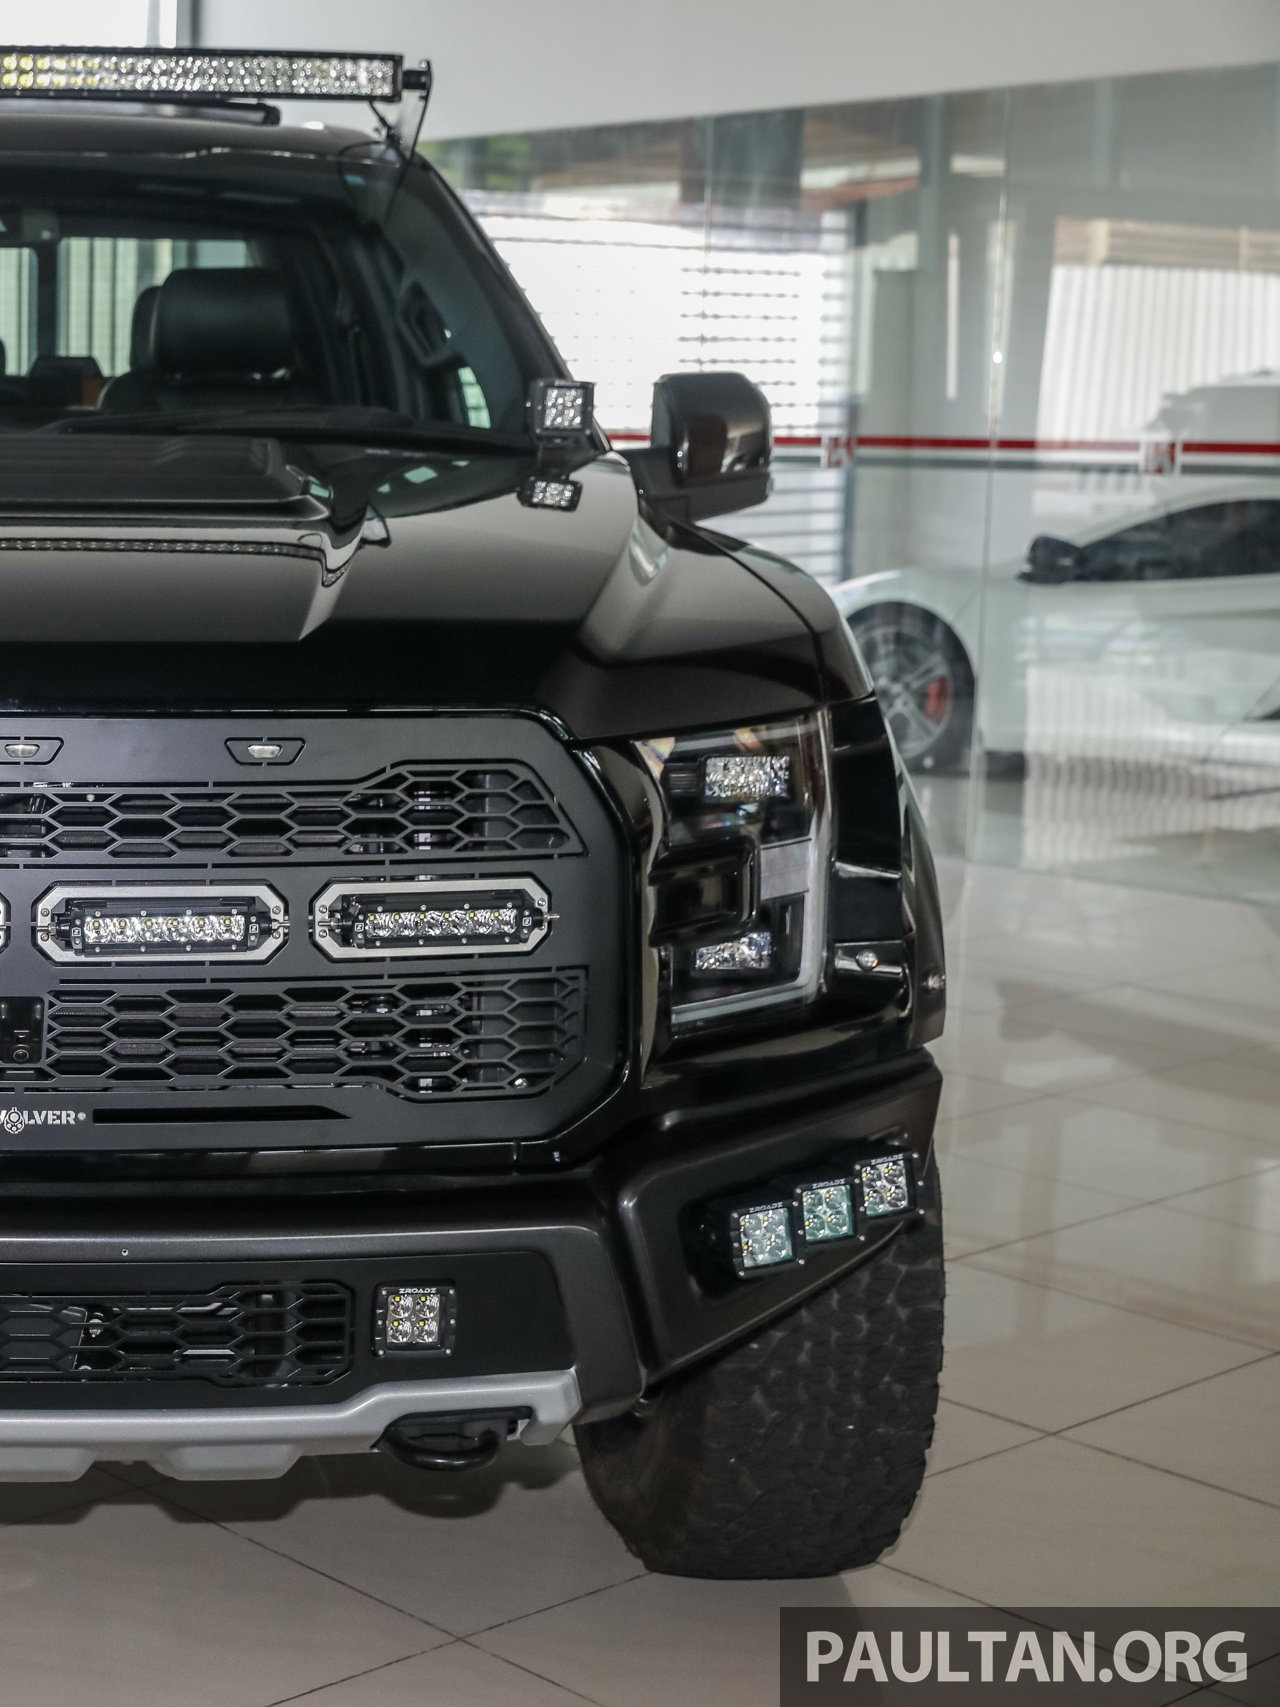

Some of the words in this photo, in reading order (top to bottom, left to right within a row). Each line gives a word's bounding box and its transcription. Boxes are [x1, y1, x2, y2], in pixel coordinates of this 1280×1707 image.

[870, 1154, 904, 1165] ZROADZ
[812, 1178, 846, 1189] ZROADZ
[748, 1202, 784, 1213] ZROADZ
